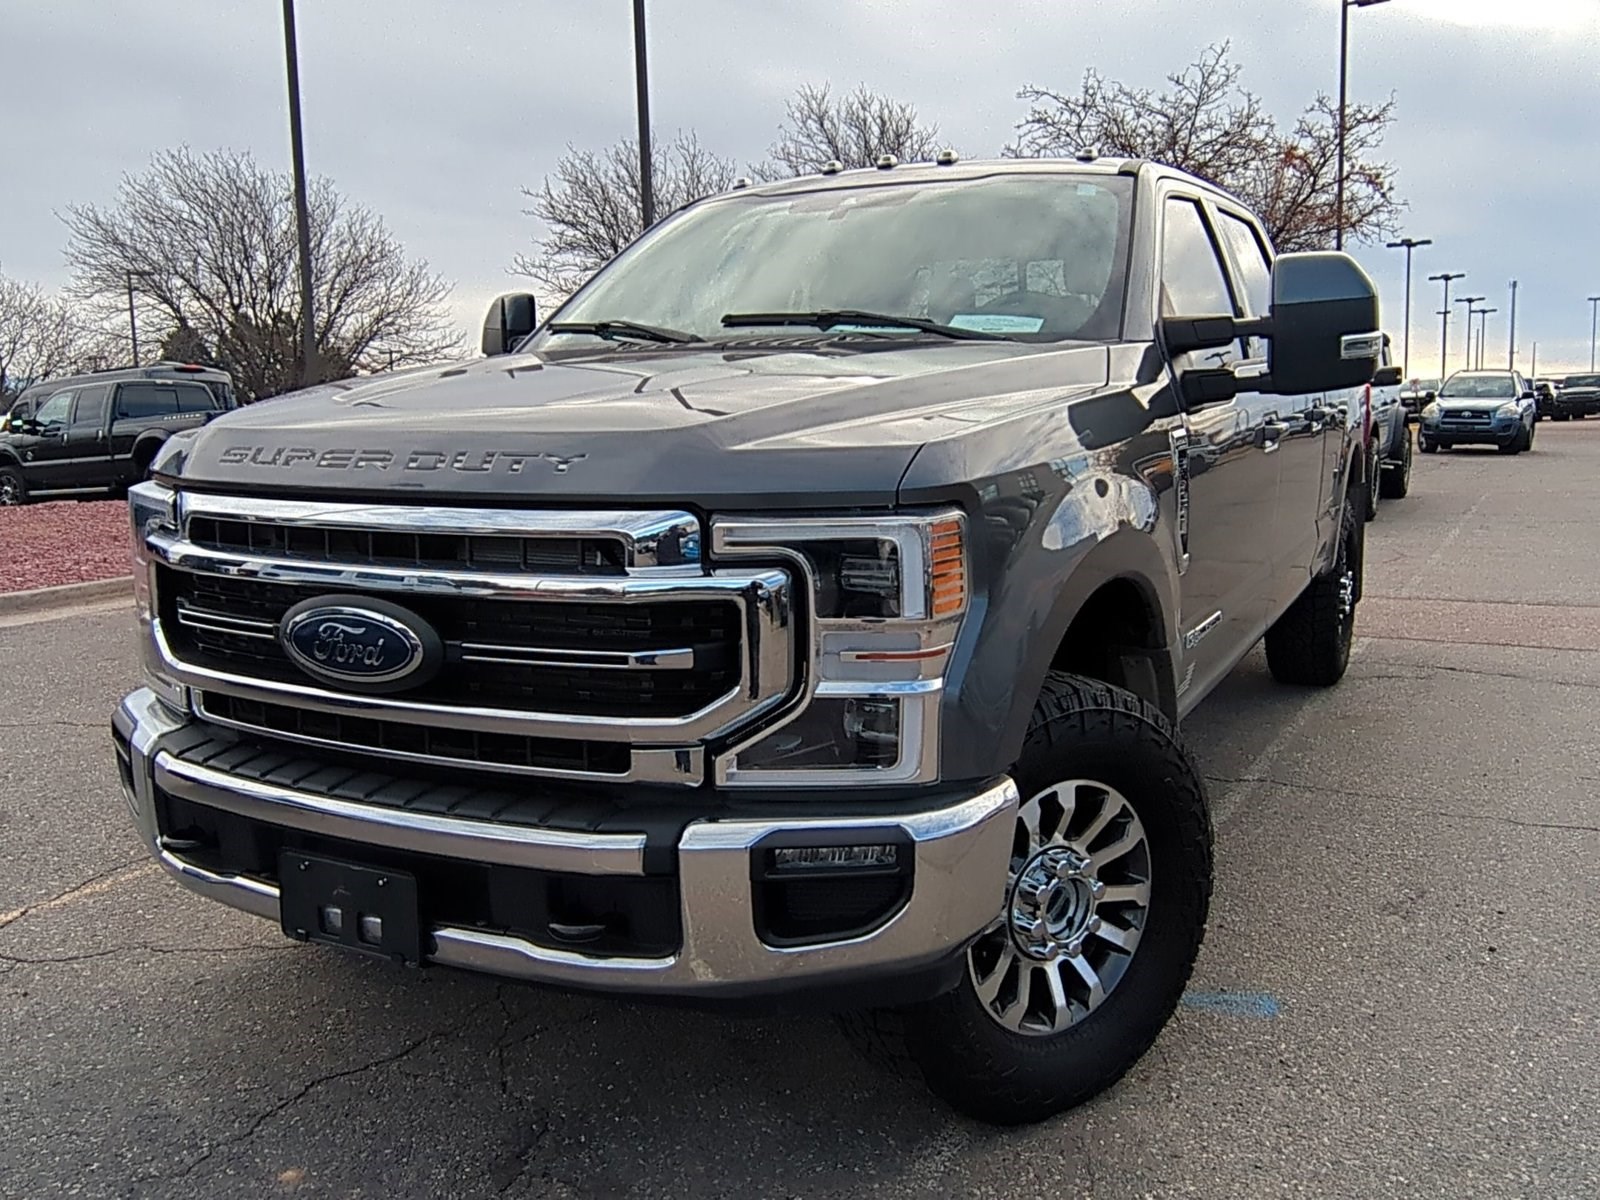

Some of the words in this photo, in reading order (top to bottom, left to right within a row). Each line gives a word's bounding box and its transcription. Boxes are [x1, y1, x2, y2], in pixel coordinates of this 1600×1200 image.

[219, 446, 395, 470] SUPER
[404, 450, 590, 475] DUTY
[313, 622, 385, 666] Ford
